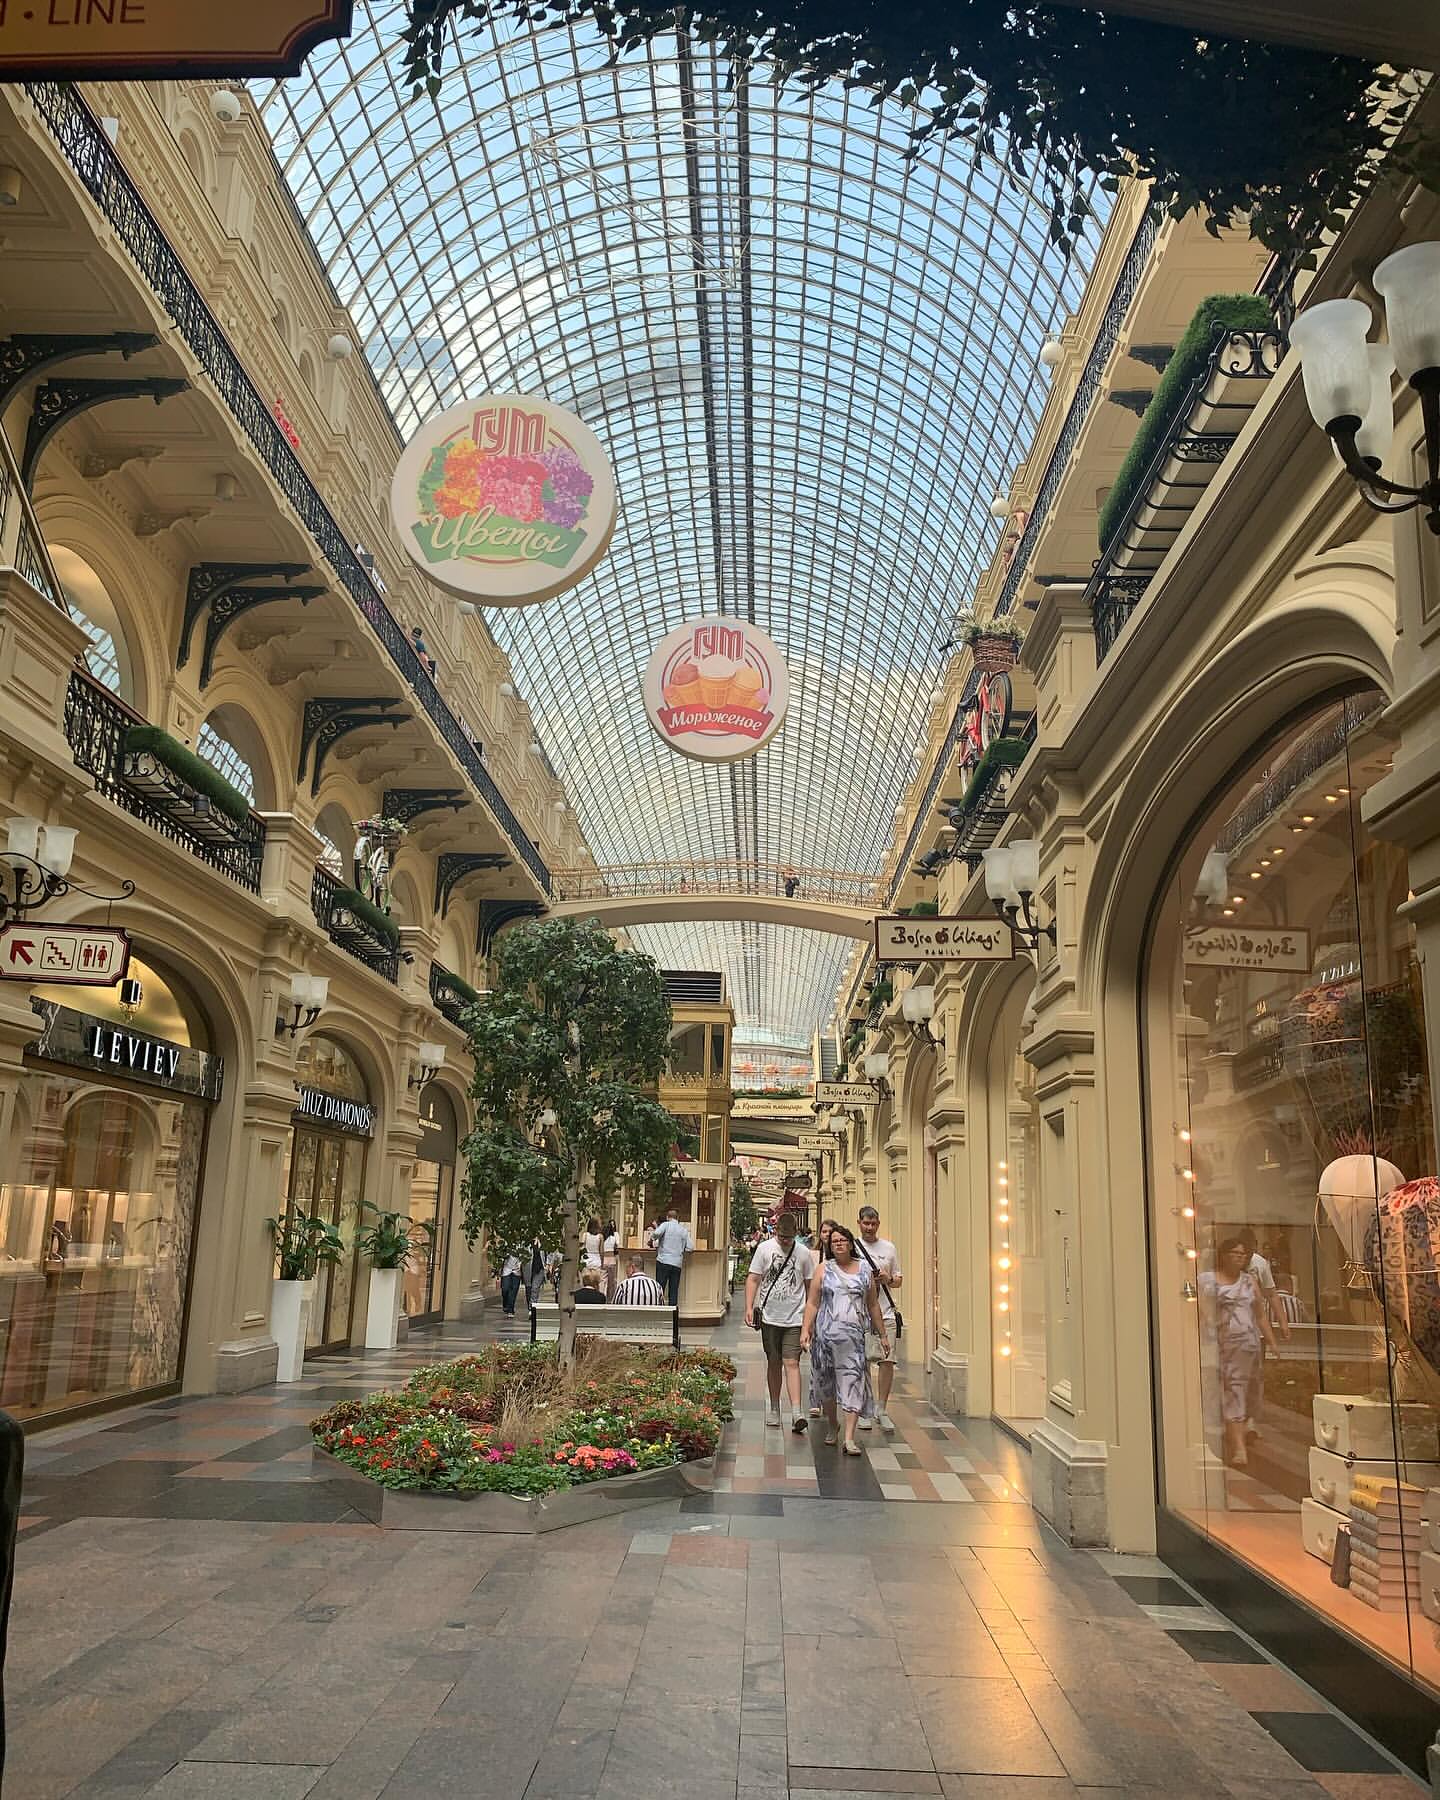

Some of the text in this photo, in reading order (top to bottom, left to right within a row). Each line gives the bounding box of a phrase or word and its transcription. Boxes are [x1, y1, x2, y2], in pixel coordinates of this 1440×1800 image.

[48, 0, 145, 25] LINE
[471, 407, 546, 457] ГУМ
[430, 504, 568, 561] Цветы
[693, 625, 744, 663] ГУМ
[669, 711, 763, 732] Мороженое
[891, 926, 932, 948] Bosco
[924, 949, 961, 957] FAMILY
[93, 1026, 181, 1080] LEVIEV
